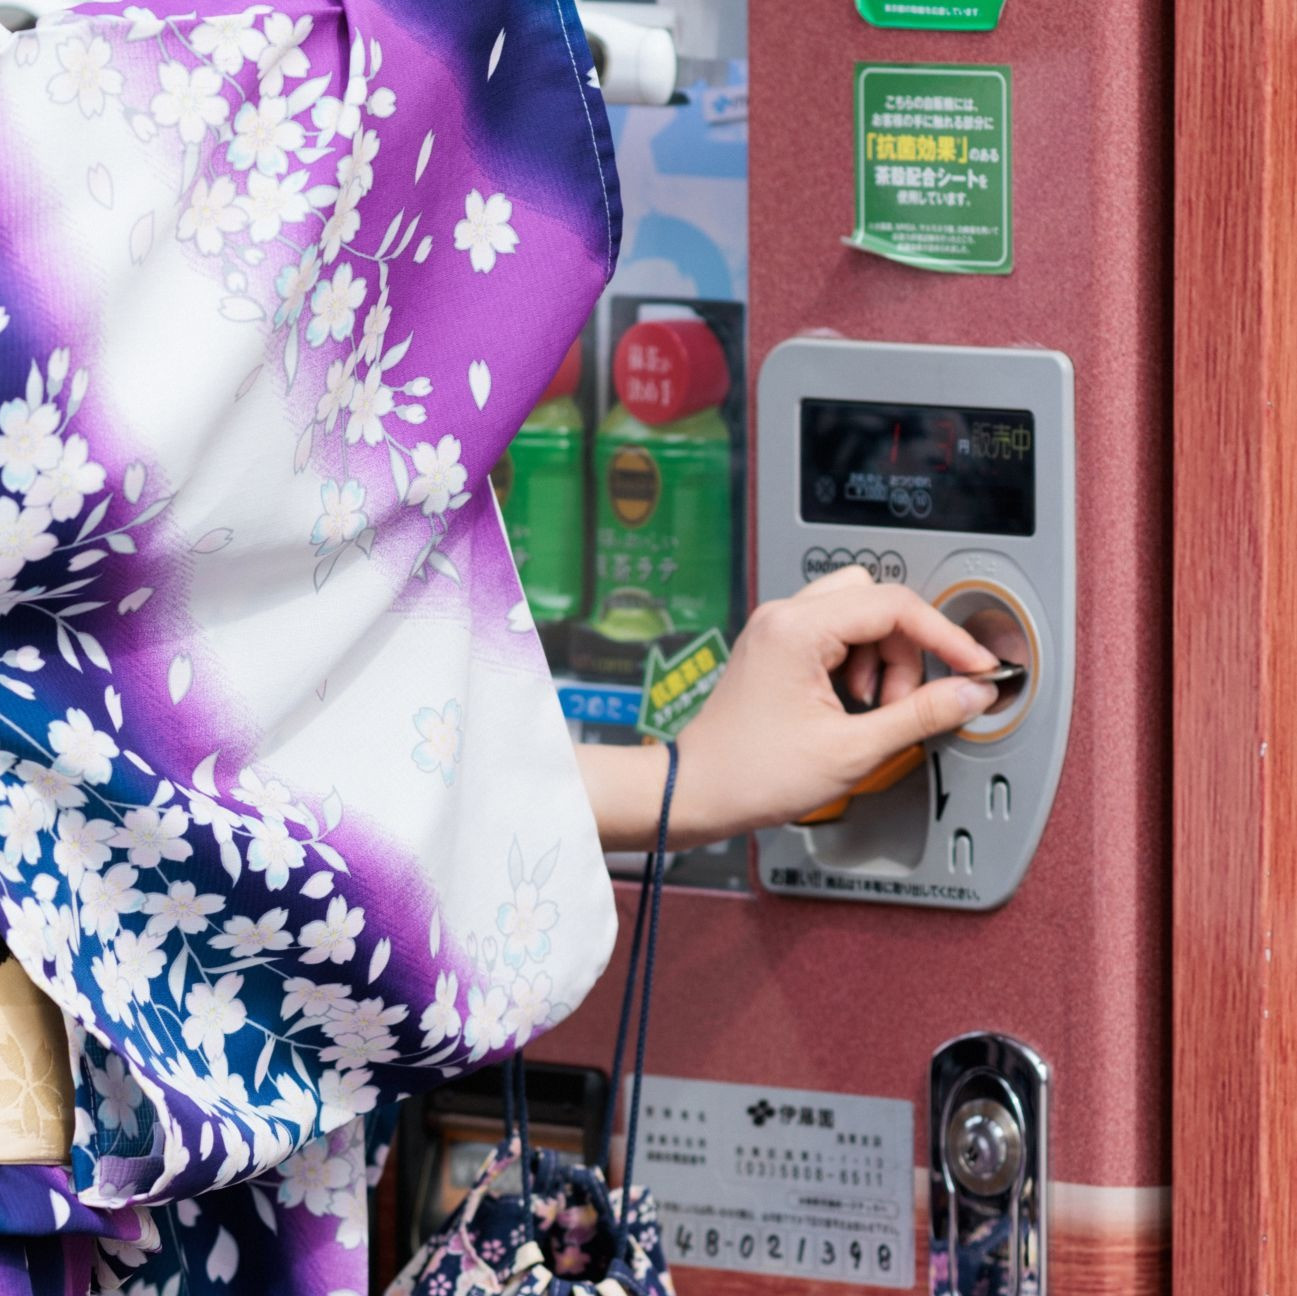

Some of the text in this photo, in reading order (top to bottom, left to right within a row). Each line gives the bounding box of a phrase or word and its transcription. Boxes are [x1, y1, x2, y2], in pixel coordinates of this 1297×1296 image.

[971, 421, 1031, 461] 販売中
[885, 564, 901, 578] 10
